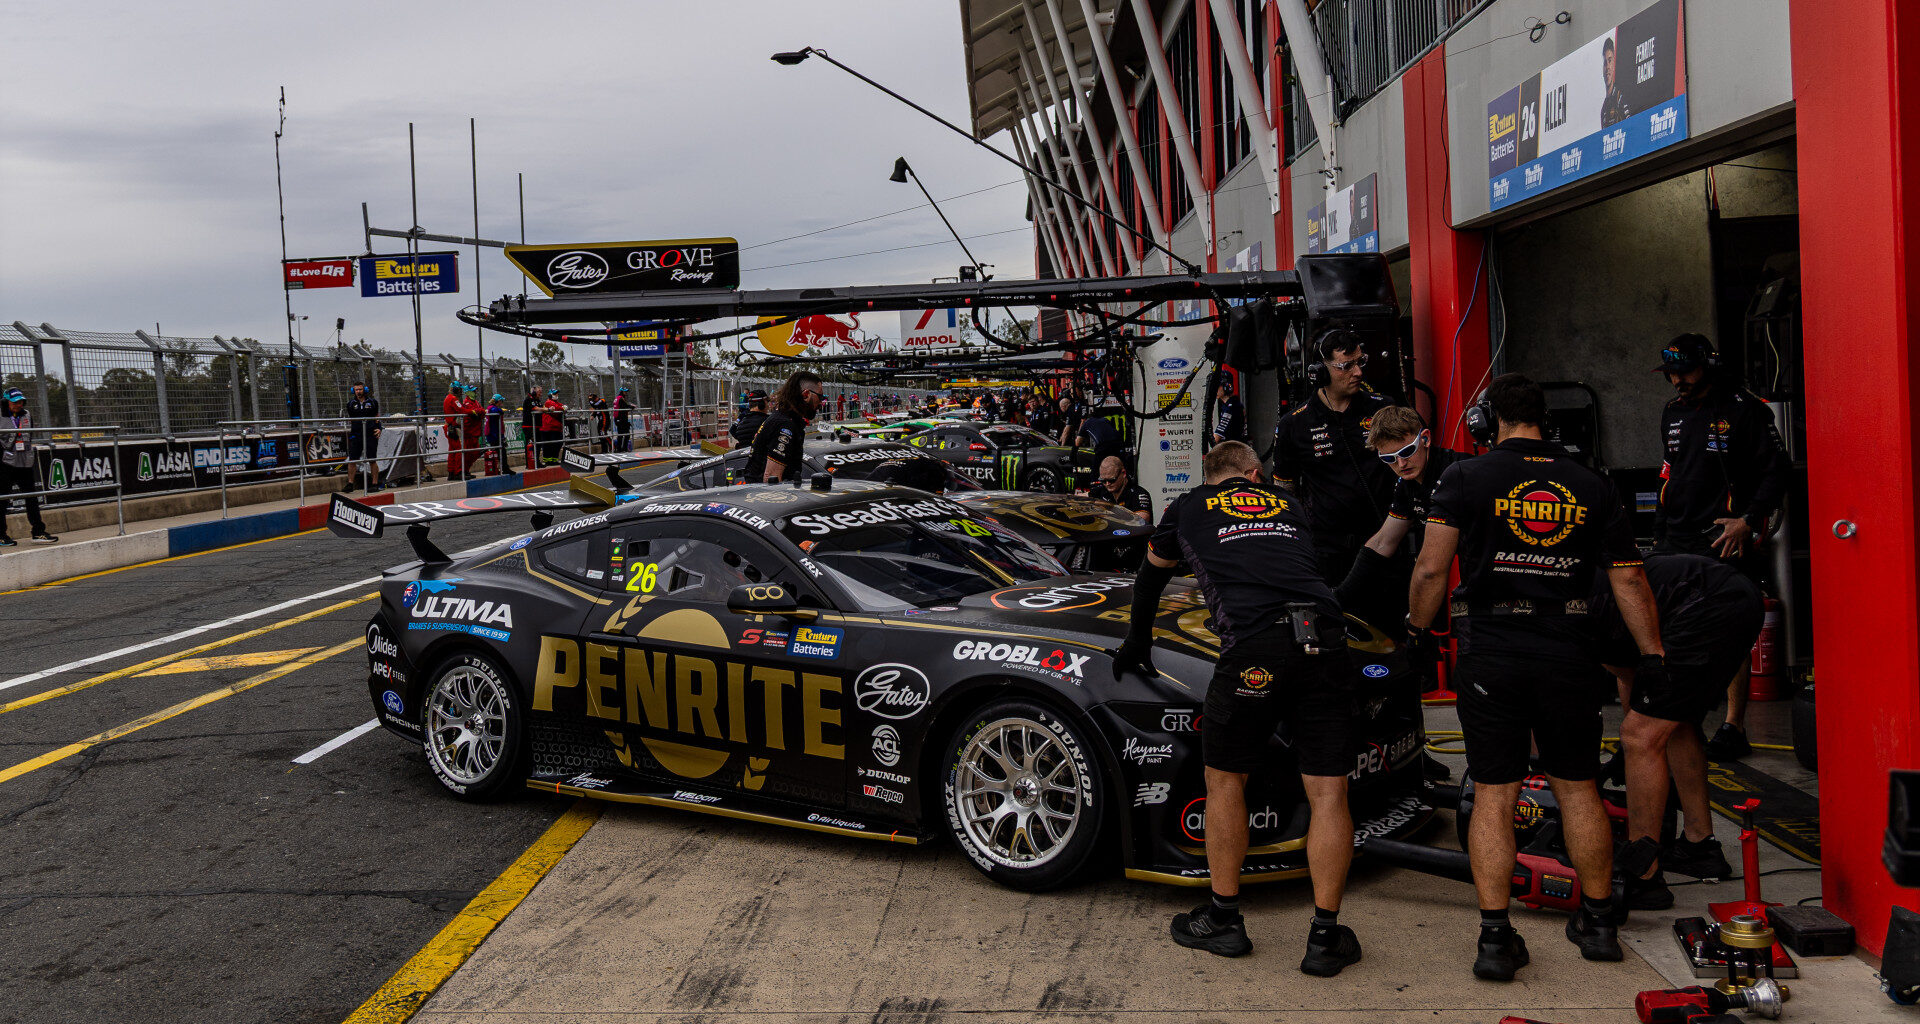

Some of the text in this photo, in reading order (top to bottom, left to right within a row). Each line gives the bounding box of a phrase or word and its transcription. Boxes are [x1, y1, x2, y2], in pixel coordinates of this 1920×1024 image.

[1635, 37, 1655, 64] PENRITE
[1637, 58, 1655, 85] RACING
[1545, 83, 1567, 132] ALLEN
[1489, 112, 1516, 142] Century
[1521, 101, 1536, 142] 26
[1650, 106, 1678, 136] Thrifty
[1490, 138, 1515, 162] Batteries
[1603, 128, 1627, 155] Thrifty
[375, 260, 440, 279] Century
[626, 248, 714, 269] GROVE
[290, 267, 321, 277] #Love
[550, 255, 606, 286] Gates
[671, 269, 714, 284] Racing
[619, 342, 659, 352] atteries
[905, 335, 957, 346] AMPOL
[1160, 413, 1193, 421] Century
[824, 447, 914, 465] Steadfast
[940, 441, 946, 450] 6
[155, 451, 192, 473] AASA
[194, 446, 251, 468] ENDLESS
[564, 450, 592, 468] Floorway
[1165, 460, 1191, 468] Partners
[71, 457, 114, 480] AASA
[1165, 473, 1190, 483] Thrifty
[377, 490, 578, 520] GROVE
[639, 502, 703, 514] Snap-on
[1205, 496, 1290, 511] PENRITE
[1494, 498, 1588, 525] PENRITE
[333, 499, 379, 531] Floorway
[554, 513, 611, 535] AUTODESK
[722, 506, 771, 530] ALLEN
[791, 499, 953, 535] Steadfast
[1218, 522, 1275, 535] RACING
[1219, 532, 1250, 543] AUSTRALIAN
[1494, 551, 1556, 565] RACING
[625, 561, 659, 593] 26
[1493, 566, 1524, 574] AUSTRALIAN
[745, 585, 784, 601] 100
[411, 596, 513, 629] ULTIMA
[431, 622, 470, 632] SUSPENSION
[473, 626, 508, 640] SINCE 1997
[795, 627, 839, 645] Century
[368, 626, 398, 658] Midea
[792, 643, 835, 657] Batteries
[372, 660, 393, 679] APEX
[952, 640, 1091, 678] GROBLOX
[471, 658, 511, 710] DUNLOP
[1000, 662, 1039, 673] POWERED
[1050, 671, 1083, 686] GROVE
[1240, 672, 1274, 682] PENRITE
[532, 636, 846, 760] PENRITE
[857, 669, 925, 710] Gates
[385, 713, 421, 732] RACING
[872, 737, 901, 755] ACL
[1122, 737, 1173, 765] Haymes
[423, 741, 467, 795] SPORT MAXX
[1048, 720, 1094, 807] DUNLOP
[866, 768, 912, 784] DUNLOP
[875, 785, 904, 804] Repco
[944, 781, 996, 872] SPORT MAXX
